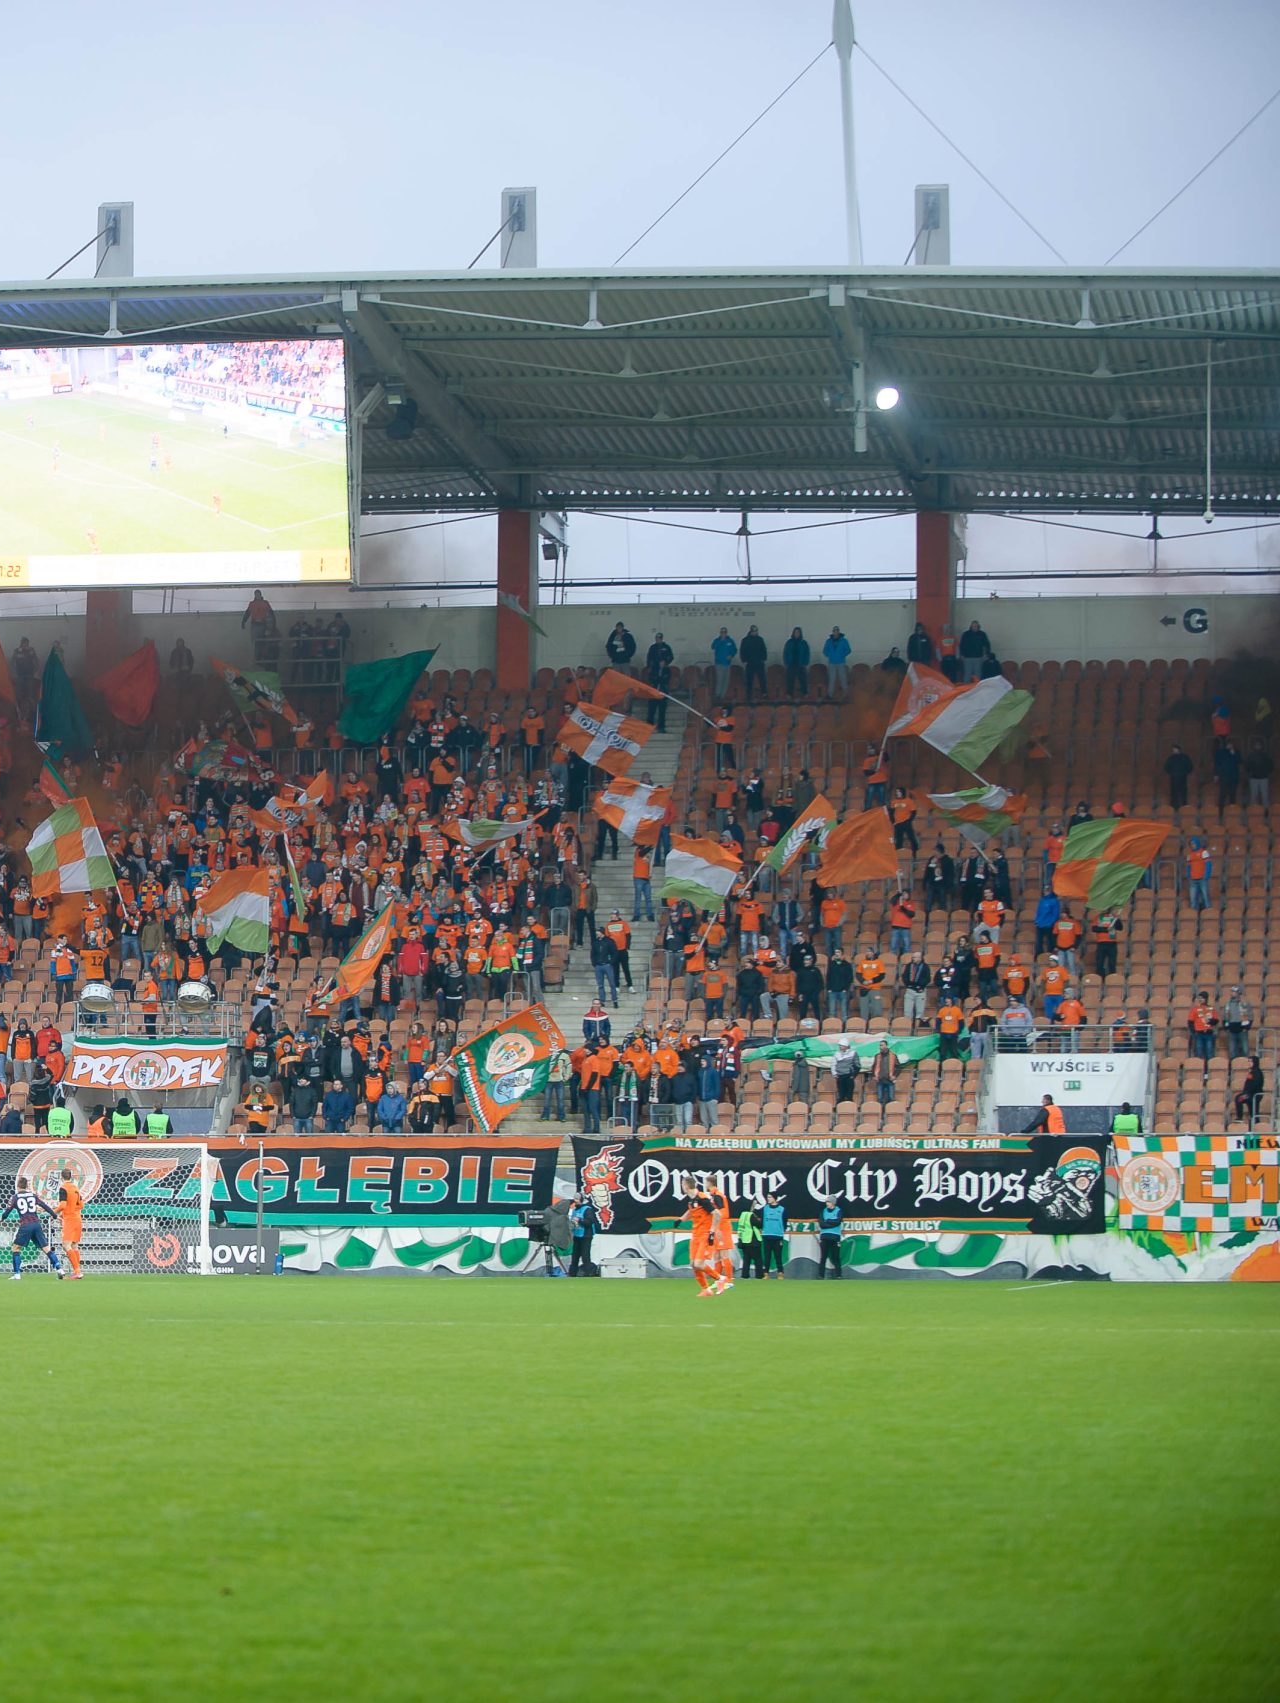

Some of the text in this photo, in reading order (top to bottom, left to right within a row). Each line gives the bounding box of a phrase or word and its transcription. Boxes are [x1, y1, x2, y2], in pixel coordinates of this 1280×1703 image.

[1183, 607, 1209, 634] G
[1030, 1059, 1115, 1073] WYJŚCIE 5
[675, 1136, 1001, 1151] NA ZAGŁĘBIU WYCHOWANI MY LUBIŃSCY ULTRAS FANI
[124, 1155, 537, 1214] ZAGŁĘBIE
[628, 1157, 1027, 1213] Orange City Boys
[17, 1197, 37, 1215] 93
[891, 1220, 941, 1231] STOLICY
